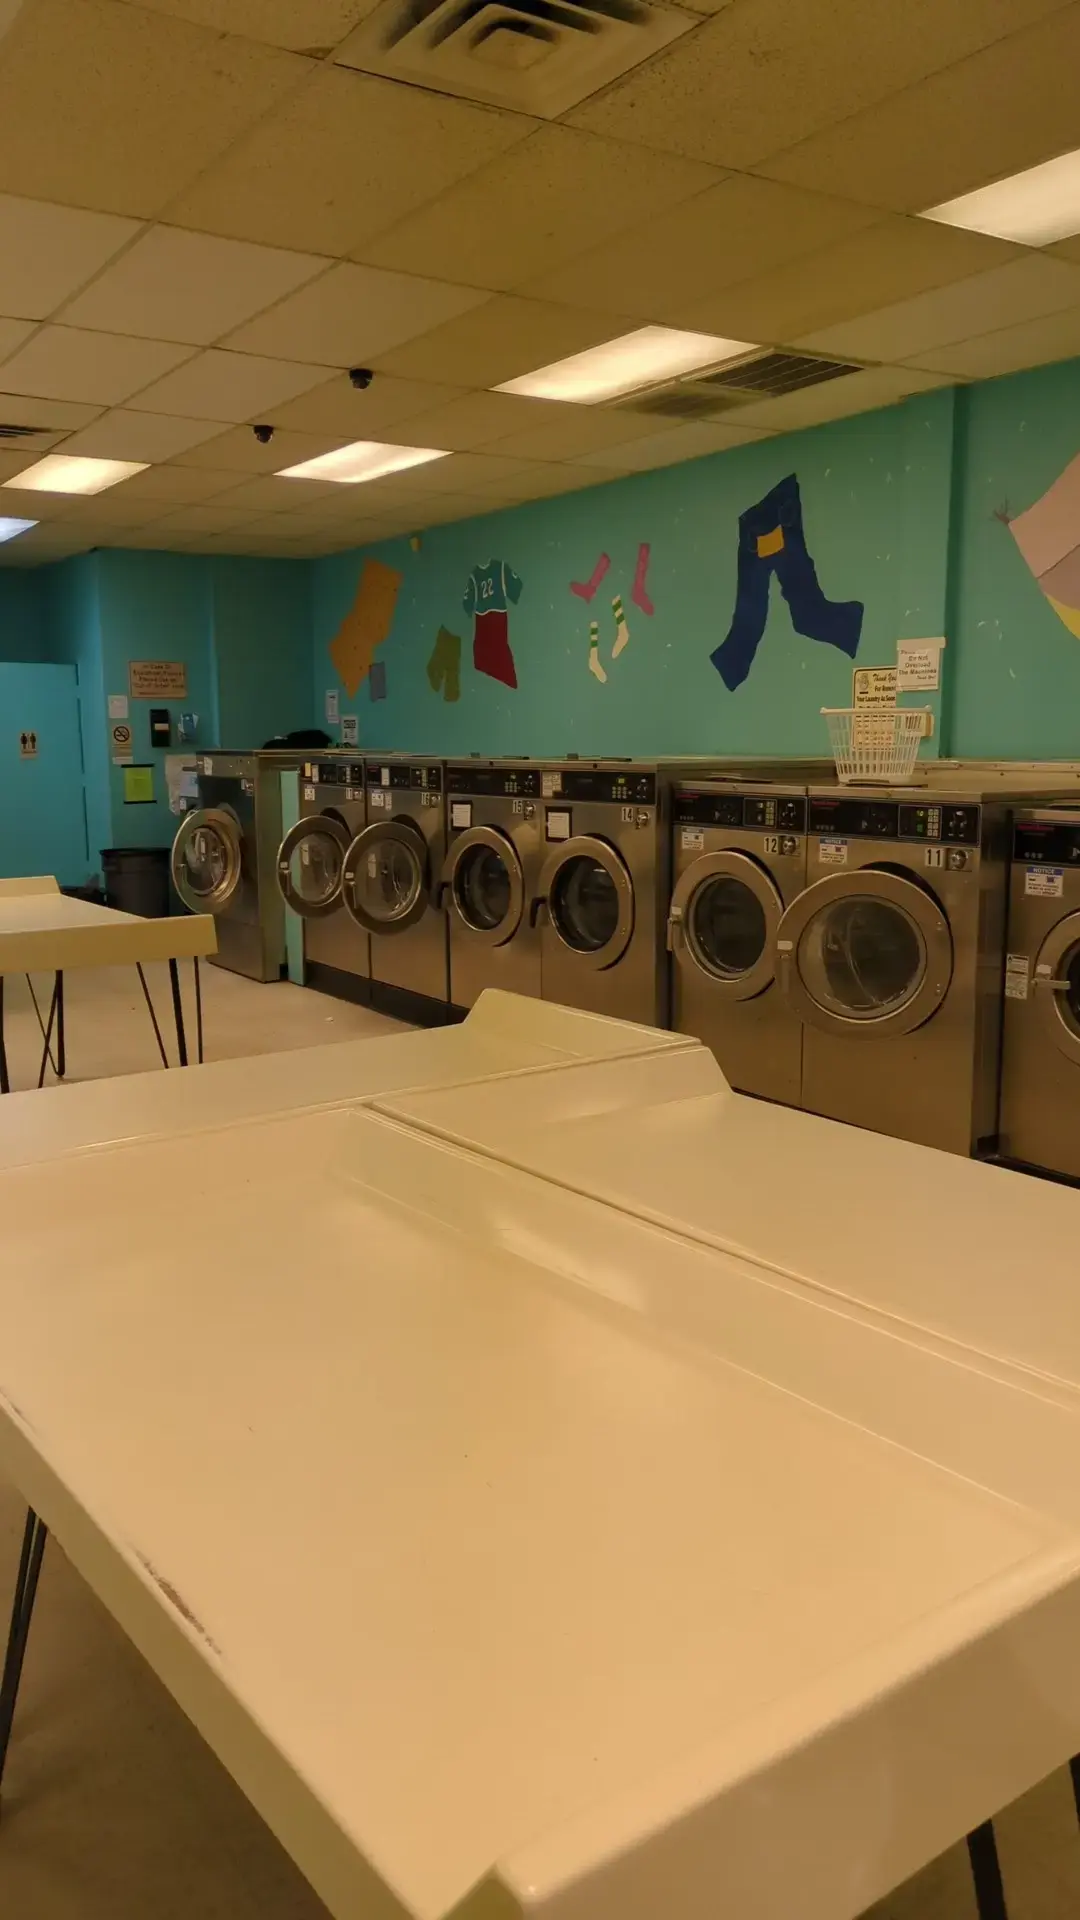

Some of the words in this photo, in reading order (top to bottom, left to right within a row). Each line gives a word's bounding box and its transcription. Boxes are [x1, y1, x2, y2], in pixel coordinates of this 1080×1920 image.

[481, 578, 494, 598] 22
[872, 673, 887, 682] Thank
[865, 695, 881, 703] Laundry
[886, 694, 896, 702] Soon
[623, 808, 632, 821] 14
[765, 837, 777, 853] 12
[926, 848, 942, 867] 11
[1032, 867, 1056, 876] NOTICE
